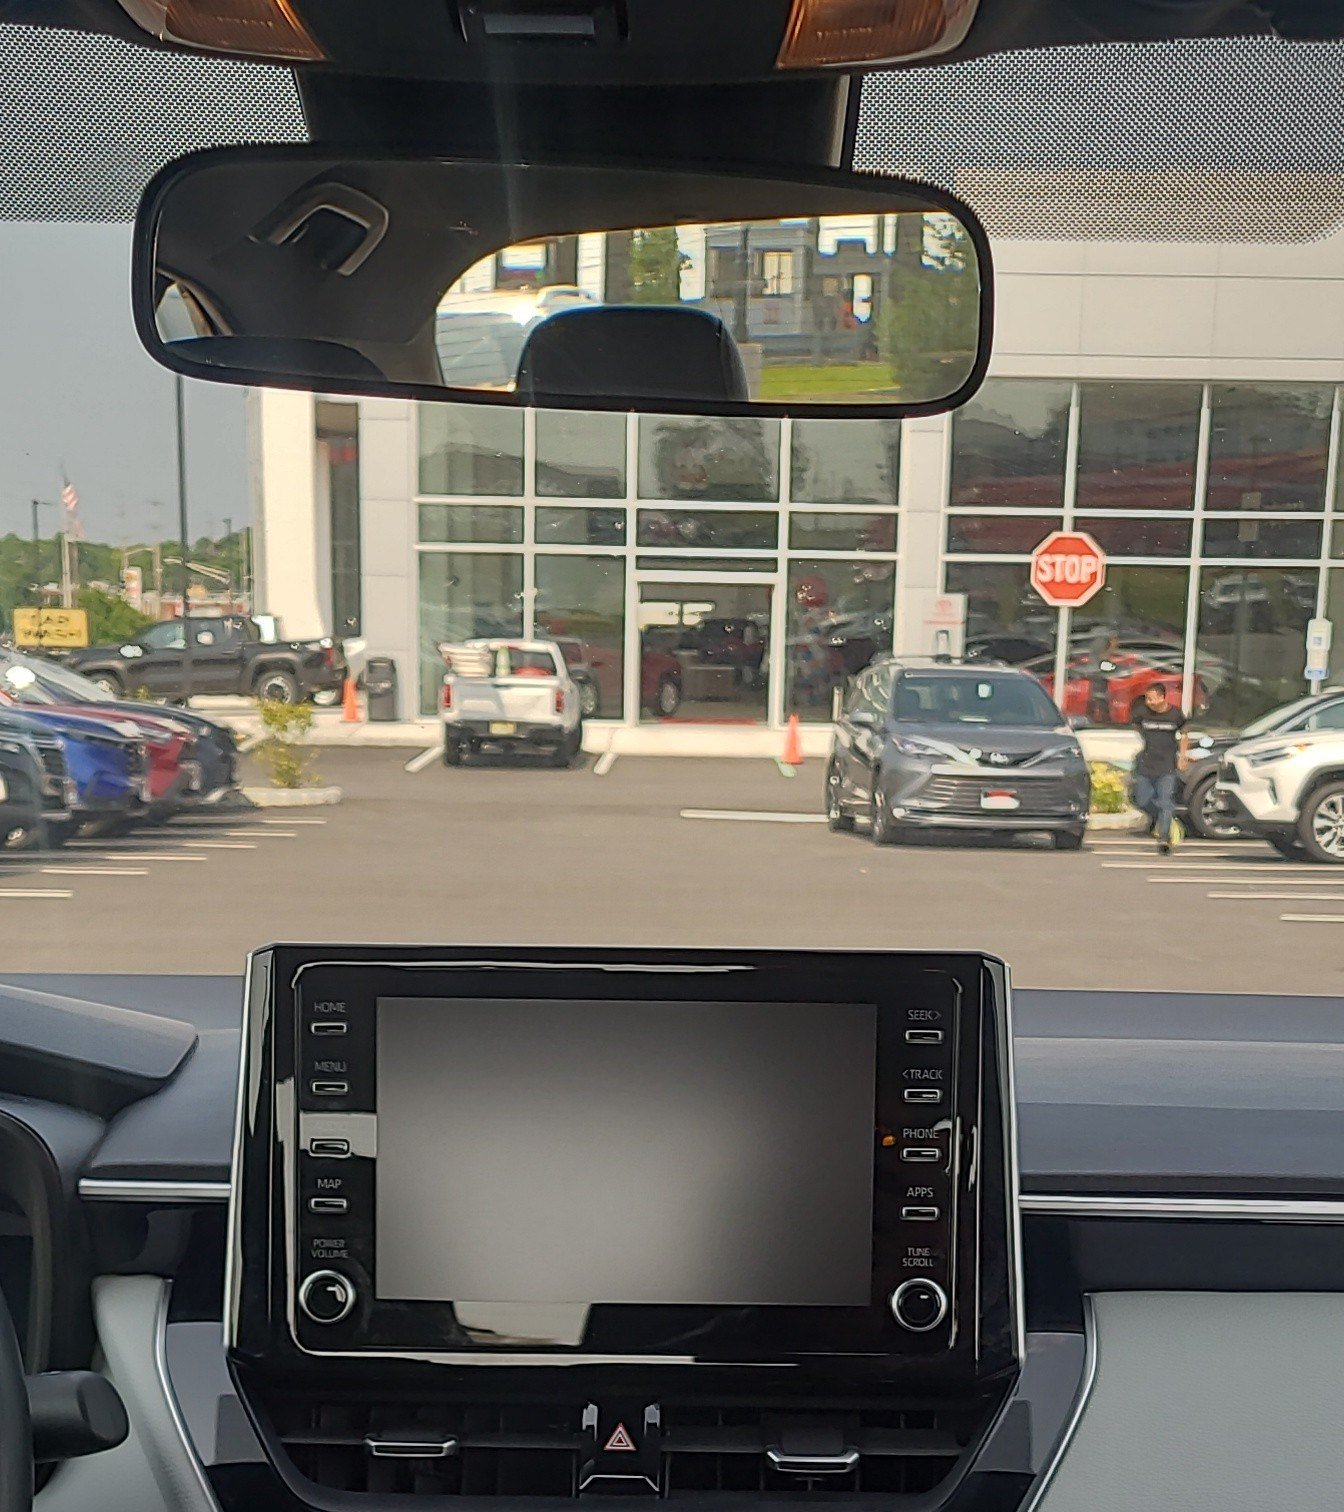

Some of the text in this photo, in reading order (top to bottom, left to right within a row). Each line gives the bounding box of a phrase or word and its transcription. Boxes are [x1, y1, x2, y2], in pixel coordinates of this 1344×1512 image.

[1036, 553, 1097, 584] STOP
[314, 1001, 347, 1013] HOME
[314, 1061, 347, 1073] MENU
[902, 1128, 940, 1139] PHONE
[317, 1178, 343, 1189] MAP
[906, 1187, 934, 1198] APPS
[312, 1238, 346, 1249] POWER
[311, 1249, 349, 1259] VOLUME
[907, 1247, 931, 1257] TUNE
[902, 1257, 934, 1267] SCROLL
